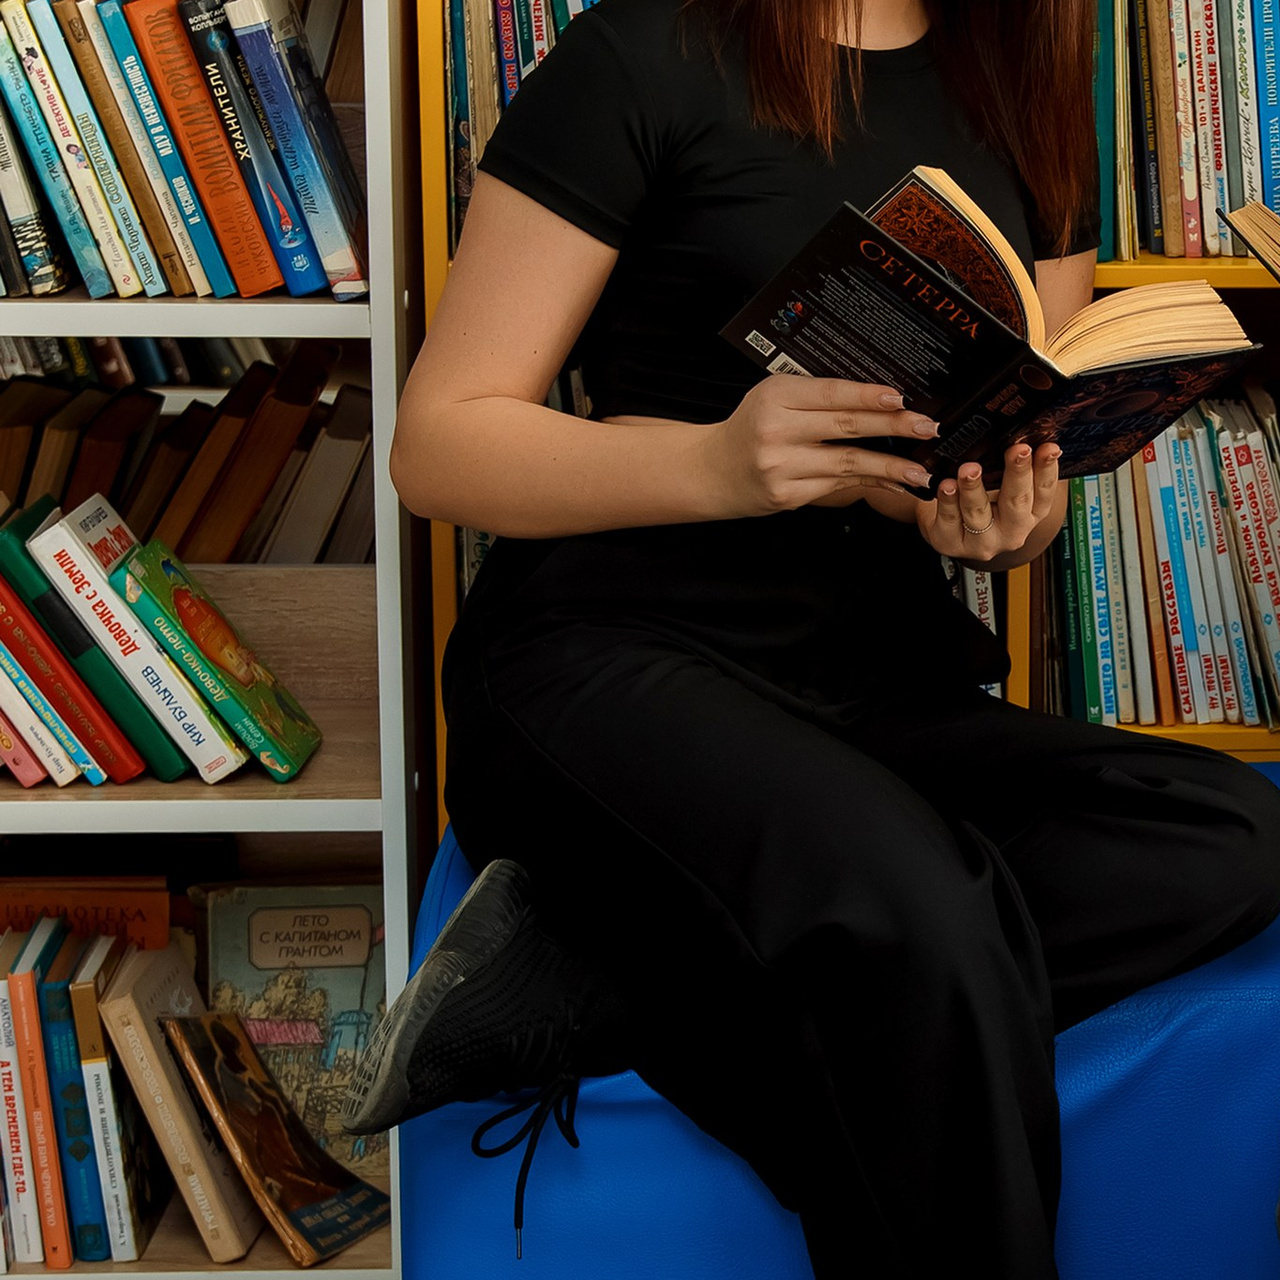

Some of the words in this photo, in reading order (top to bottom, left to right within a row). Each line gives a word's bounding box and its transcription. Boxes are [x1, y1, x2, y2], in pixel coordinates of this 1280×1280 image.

[1261, 26, 1279, 106] ПОКОРИТЕЛИ
[205, 62, 251, 161] ХРАНИТЕЛИ
[858, 239, 980, 341] СЕТЕРРА
[1160, 560, 1181, 636] РАССКАЗЫ
[1172, 643, 1193, 715] СМЕШНЫЕ
[260, 932, 270, 942] С
[274, 929, 362, 943] КАПИТАНОМ
[278, 945, 344, 958] ГРАНТОМ
[292, 914, 329, 928] ЛЕТО
